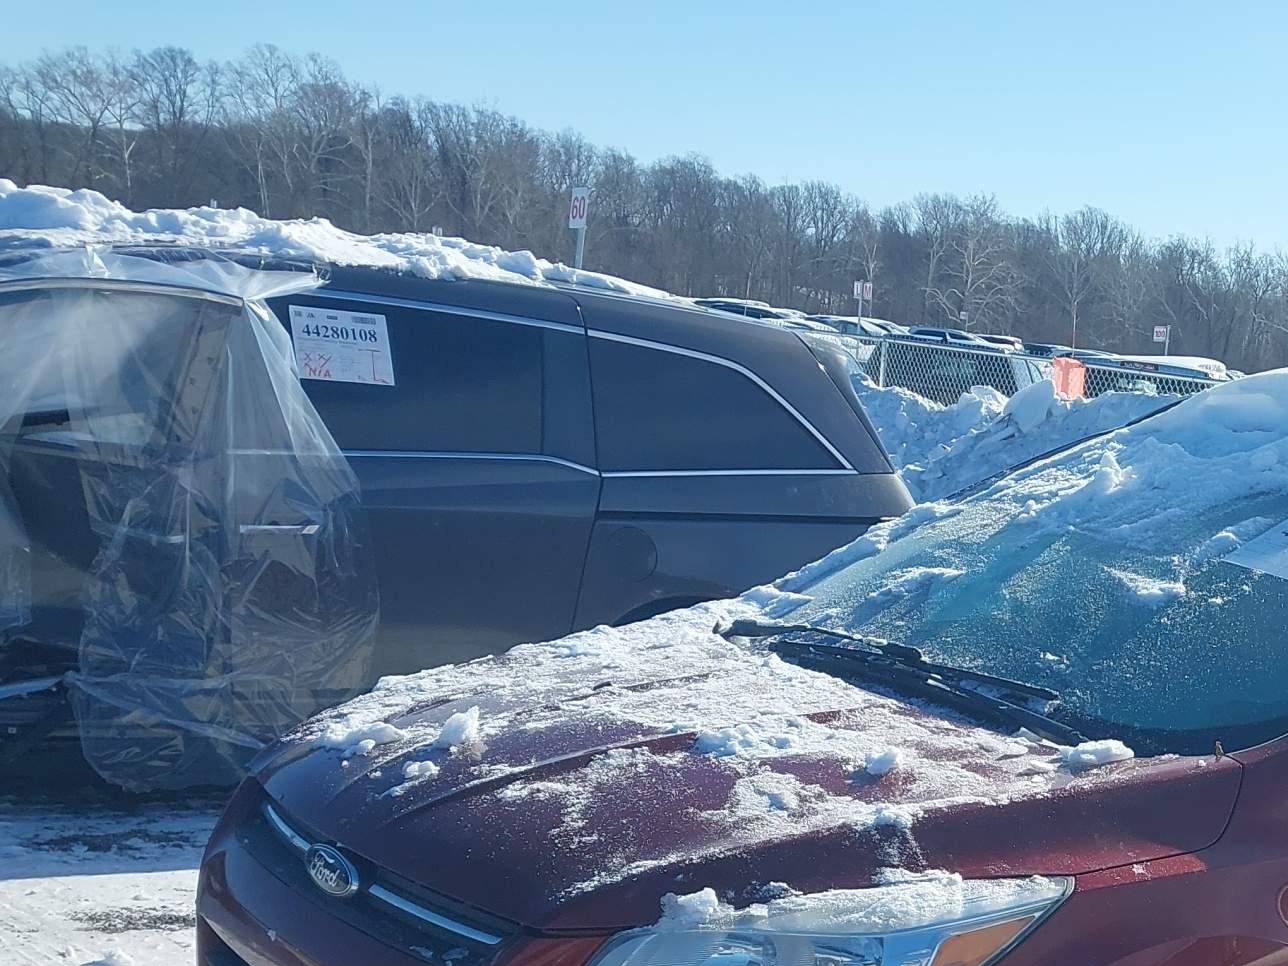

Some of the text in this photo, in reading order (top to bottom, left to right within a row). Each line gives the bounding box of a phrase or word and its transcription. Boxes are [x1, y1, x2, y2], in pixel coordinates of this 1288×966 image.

[571, 196, 586, 220] 60
[302, 324, 378, 342] 44280108
[310, 850, 341, 887] Ford
